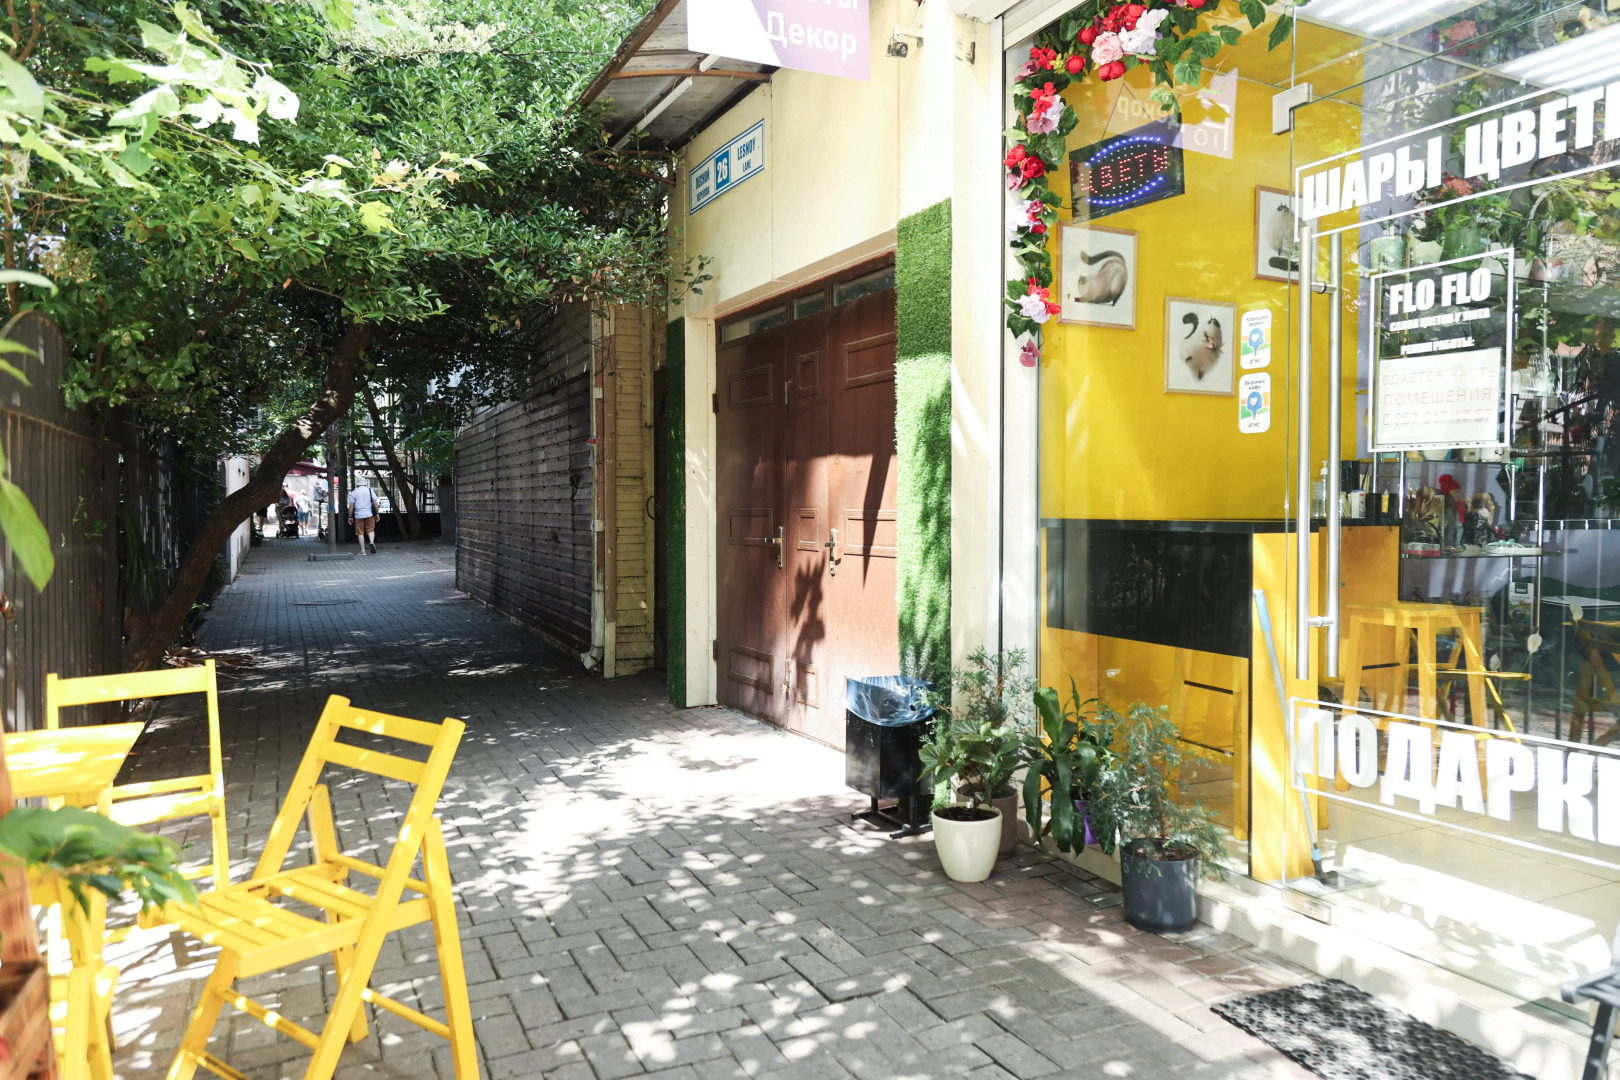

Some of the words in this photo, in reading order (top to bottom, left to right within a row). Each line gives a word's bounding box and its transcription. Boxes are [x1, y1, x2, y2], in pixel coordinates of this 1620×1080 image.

[766, 11, 857, 61] Декор
[737, 137, 756, 160] LESNOY
[743, 159, 752, 172] LANE
[717, 157, 728, 183] 26
[1080, 145, 1169, 195] ЦВЕТЫ
[1302, 135, 1442, 221] ШАРЫ
[1389, 279, 1435, 315] FLO
[1441, 268, 1491, 307] FLO
[1382, 370, 1443, 386] СДАЕТСЯ
[1450, 366, 1497, 381] ЧАСТЬ
